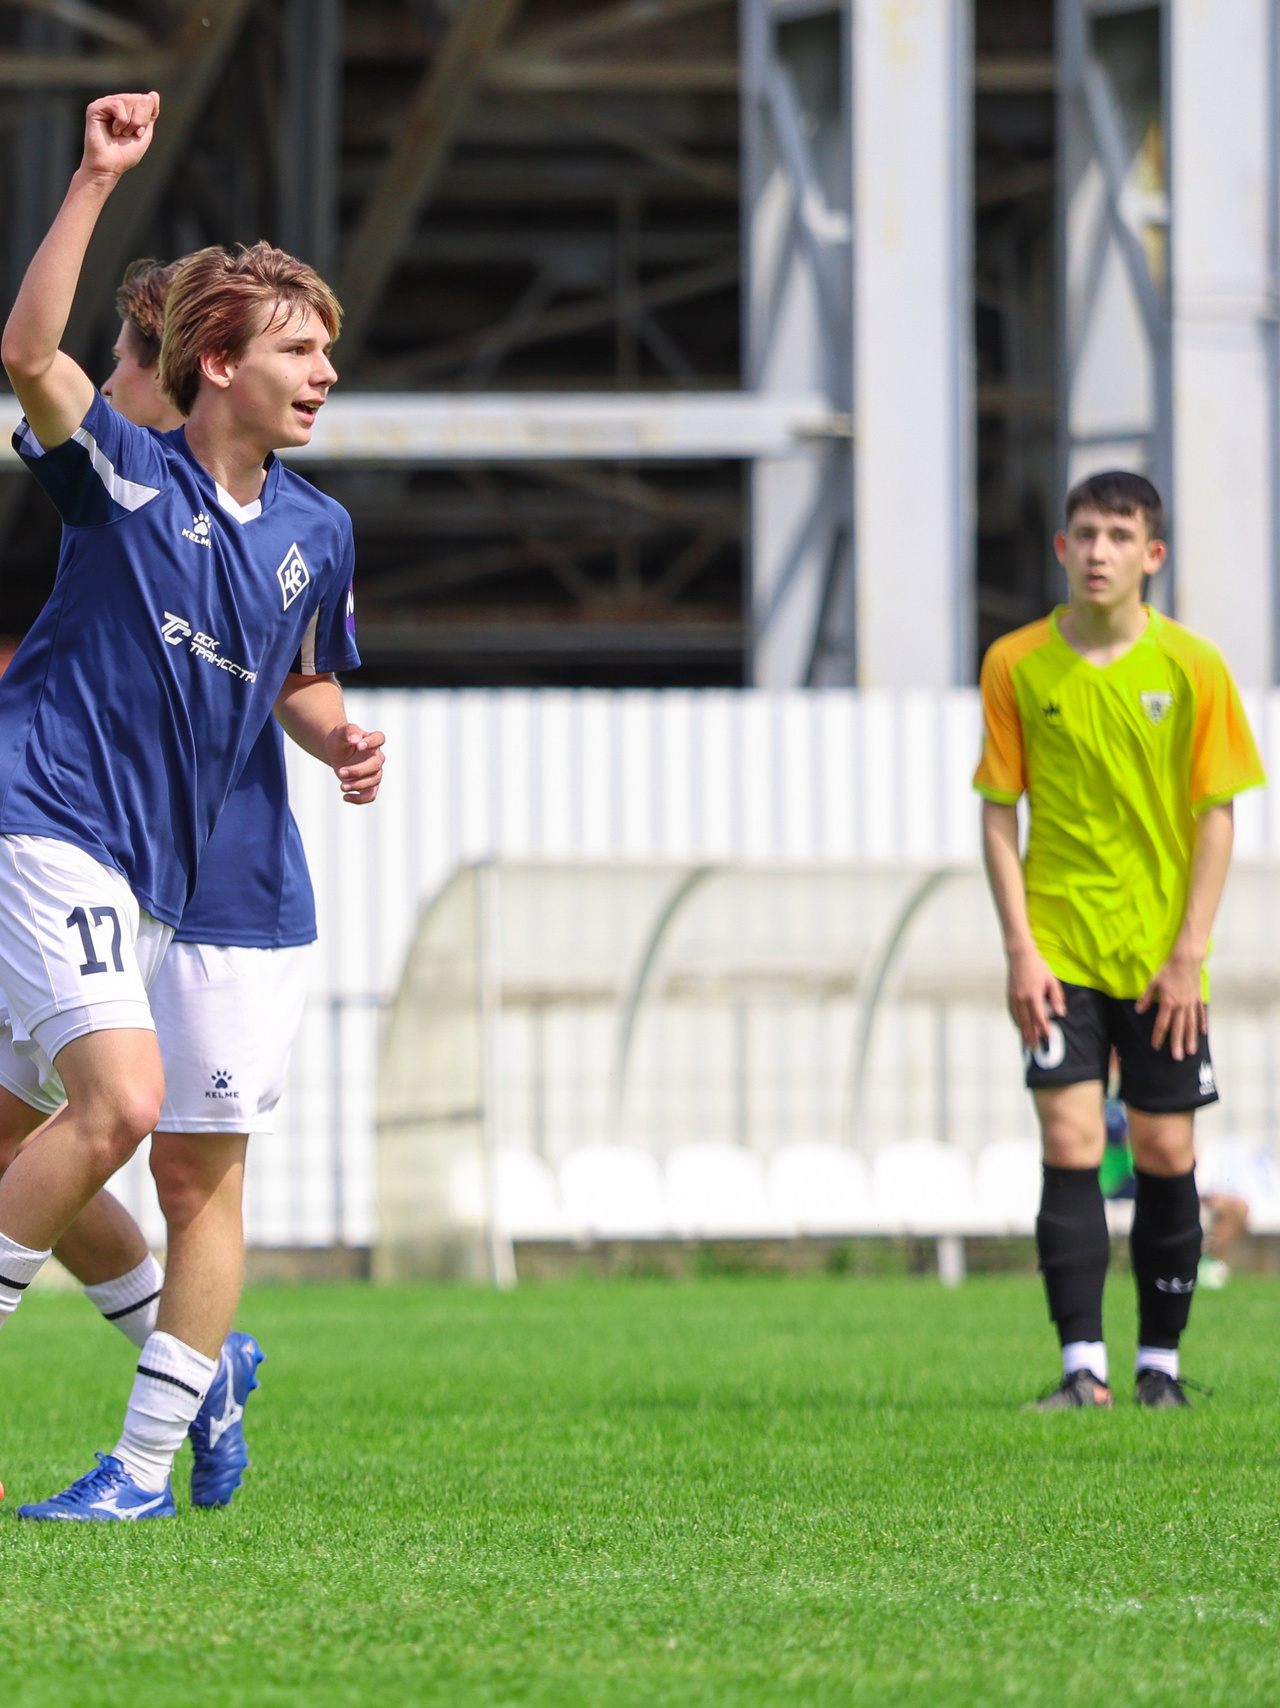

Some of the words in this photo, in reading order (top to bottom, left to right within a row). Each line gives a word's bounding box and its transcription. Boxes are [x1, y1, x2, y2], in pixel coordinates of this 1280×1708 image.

[181, 528, 212, 549] KELM
[66, 906, 125, 977] 17
[205, 1091, 240, 1099] KELME
